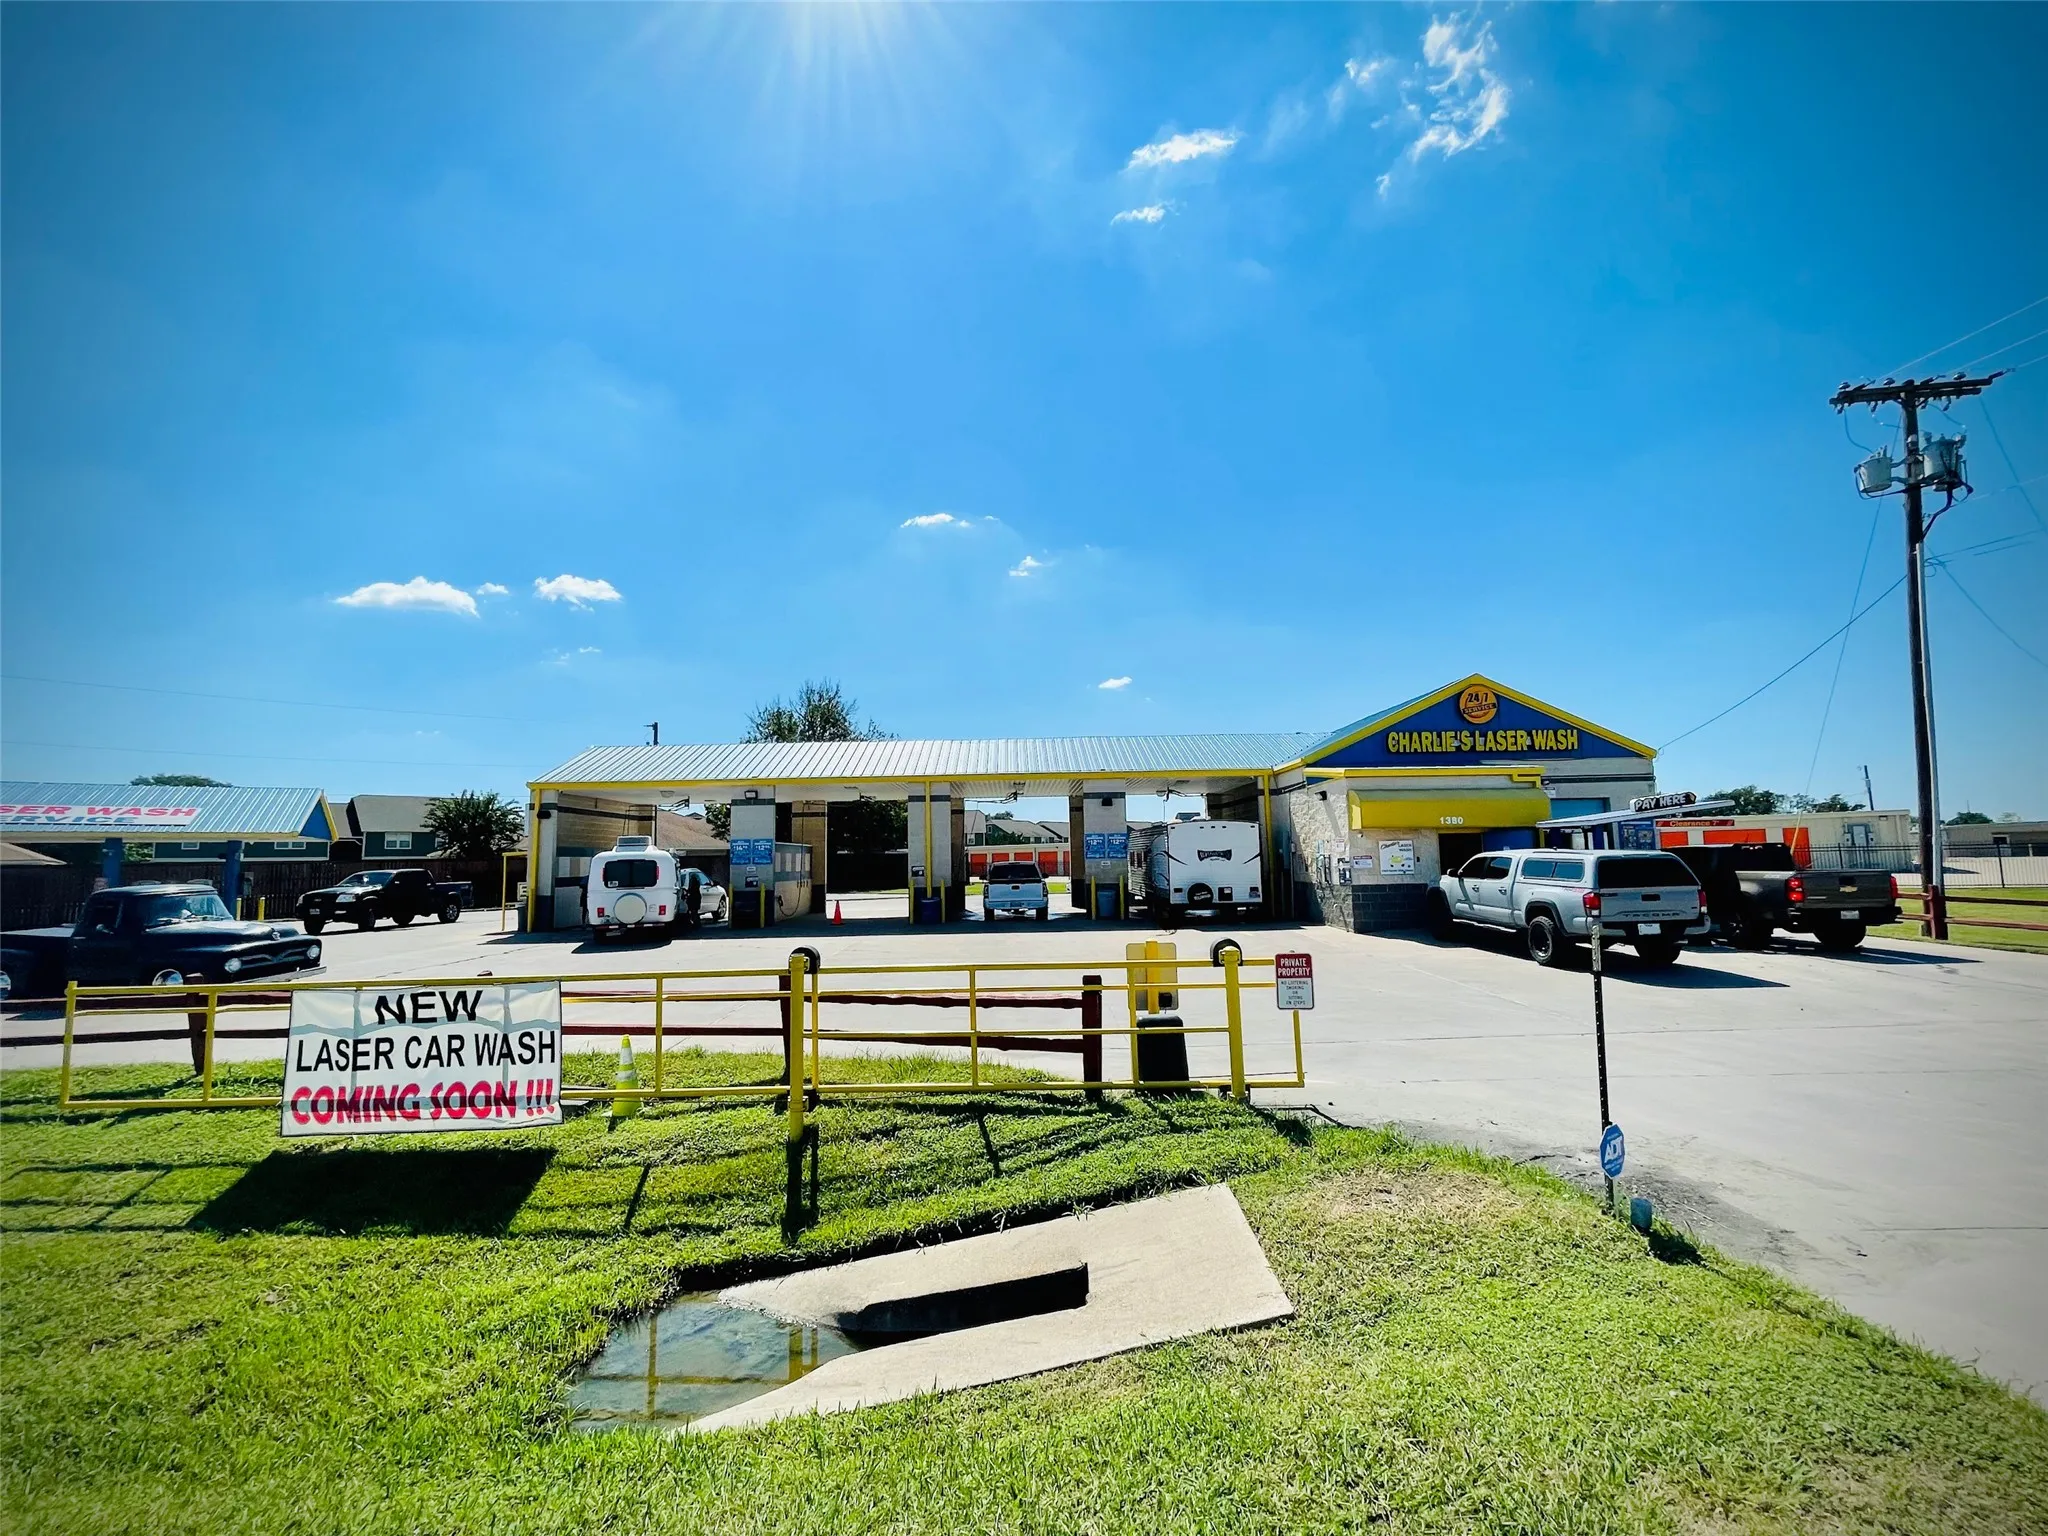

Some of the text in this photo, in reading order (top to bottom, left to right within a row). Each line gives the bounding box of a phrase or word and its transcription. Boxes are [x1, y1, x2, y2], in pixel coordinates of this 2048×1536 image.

[1463, 703, 1495, 714] SERVICE
[1387, 729, 1578, 753] CHARLIE'S LASER WASH
[1635, 794, 1686, 811] PAY HERE
[87, 806, 197, 817] WASH
[1439, 816, 1464, 825] 1380
[1280, 958, 1307, 966] PRIVATE
[1277, 968, 1311, 976] PROPERTY
[374, 989, 484, 1025] NEW
[296, 1030, 556, 1073] LASER CAR WASH
[290, 1078, 555, 1126] COMING SOON !!!
[1604, 1134, 1623, 1164] ADT
